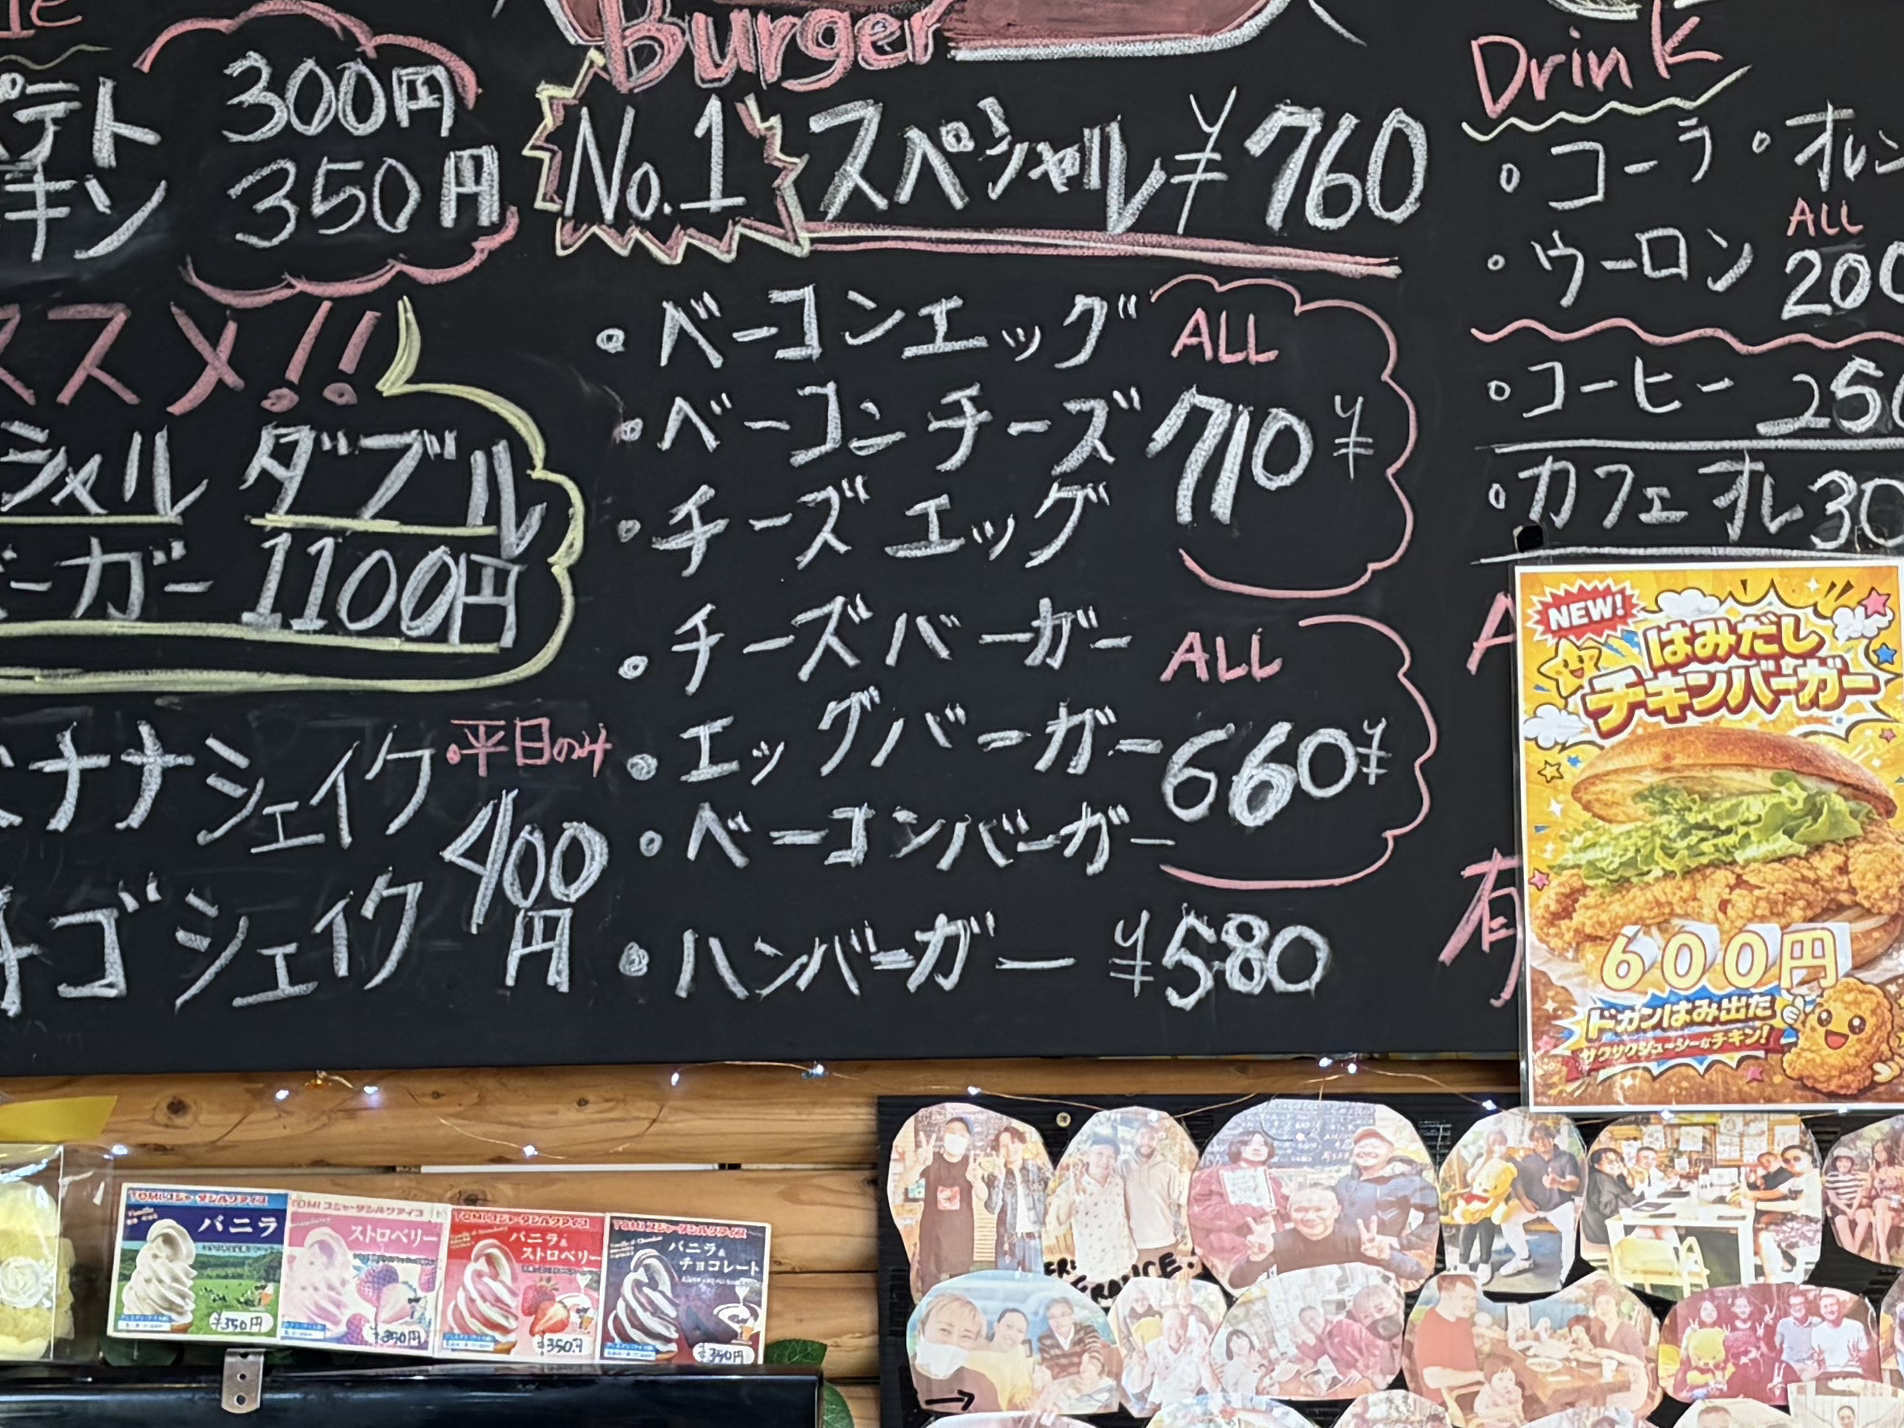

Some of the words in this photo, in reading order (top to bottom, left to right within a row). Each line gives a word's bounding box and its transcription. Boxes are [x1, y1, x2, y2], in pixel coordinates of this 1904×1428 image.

[221, 50, 453, 144] 300円
[1469, 0, 1724, 120] Drink
[226, 145, 500, 246] 350円
[564, 94, 748, 222] No.1
[810, 94, 1165, 236] スペシャル
[1170, 87, 1429, 234] ¥760
[1548, 117, 1714, 210] コーラ
[1786, 197, 1864, 238] ALL
[1530, 228, 1754, 309] ウーロン
[658, 285, 1137, 369] ベーコンエッグ
[1171, 308, 1278, 366] ALL
[656, 381, 1143, 479] ベーコンチーズ
[240, 423, 550, 558] ダブル
[652, 475, 1110, 577] チーズエッグ
[243, 531, 522, 649] 1100円
[1547, 592, 1626, 630] NEW!
[669, 593, 1133, 696] チーズバーガー
[1160, 631, 1282, 683] ALL
[1645, 613, 1828, 670] はみだし
[679, 683, 1165, 786] エッグバーガー
[1584, 659, 1884, 739] チキンバーガー
[687, 800, 1178, 876] ベーコンバーガー
[675, 910, 1079, 999] ハンバーガー
[1107, 904, 1333, 1010] ¥580
[1601, 927, 1840, 990] 600円
[1586, 993, 1773, 1040] ドカンはみ出た
[197, 1215, 279, 1239] バニラ
[349, 1224, 439, 1246] ストロベリー
[521, 1246, 603, 1262] ストロベリー
[679, 1257, 760, 1275] チョコレート
